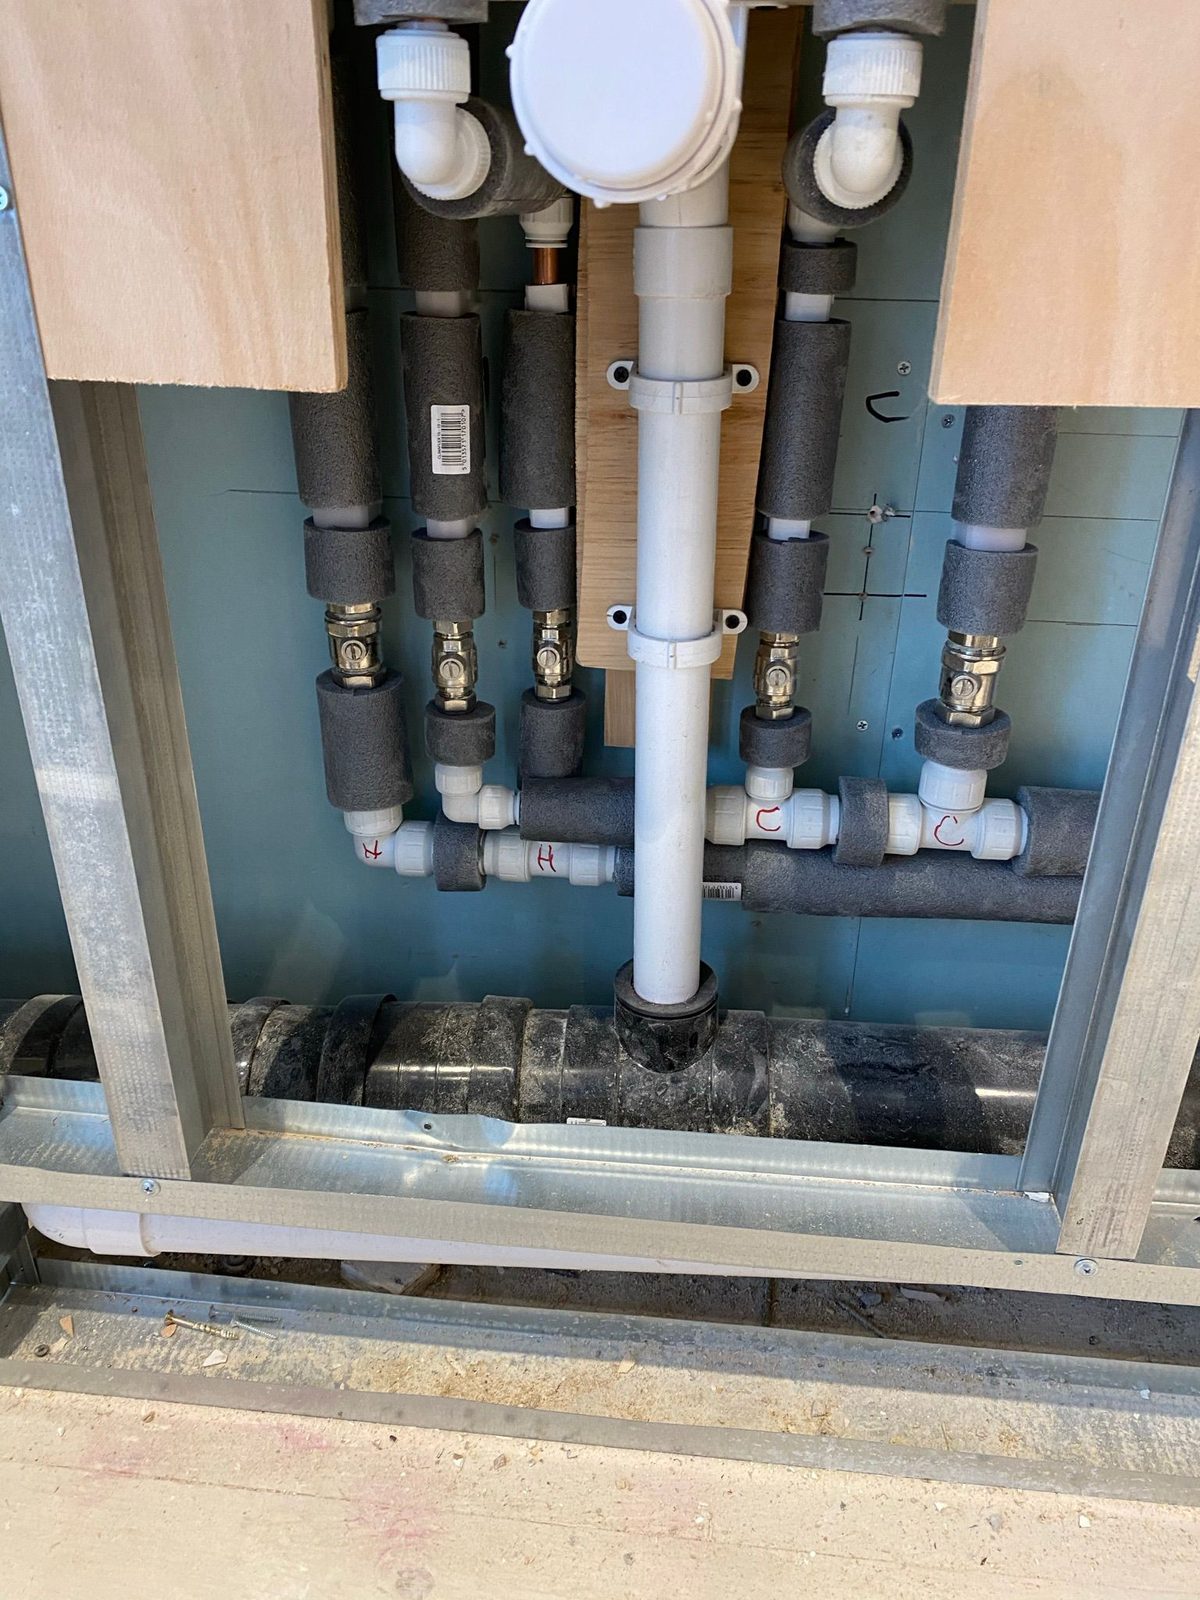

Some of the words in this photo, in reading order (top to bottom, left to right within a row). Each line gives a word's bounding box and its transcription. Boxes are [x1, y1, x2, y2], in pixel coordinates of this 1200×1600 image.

[756, 806, 781, 831] C
[933, 814, 965, 847] C
[537, 844, 556, 873] H
